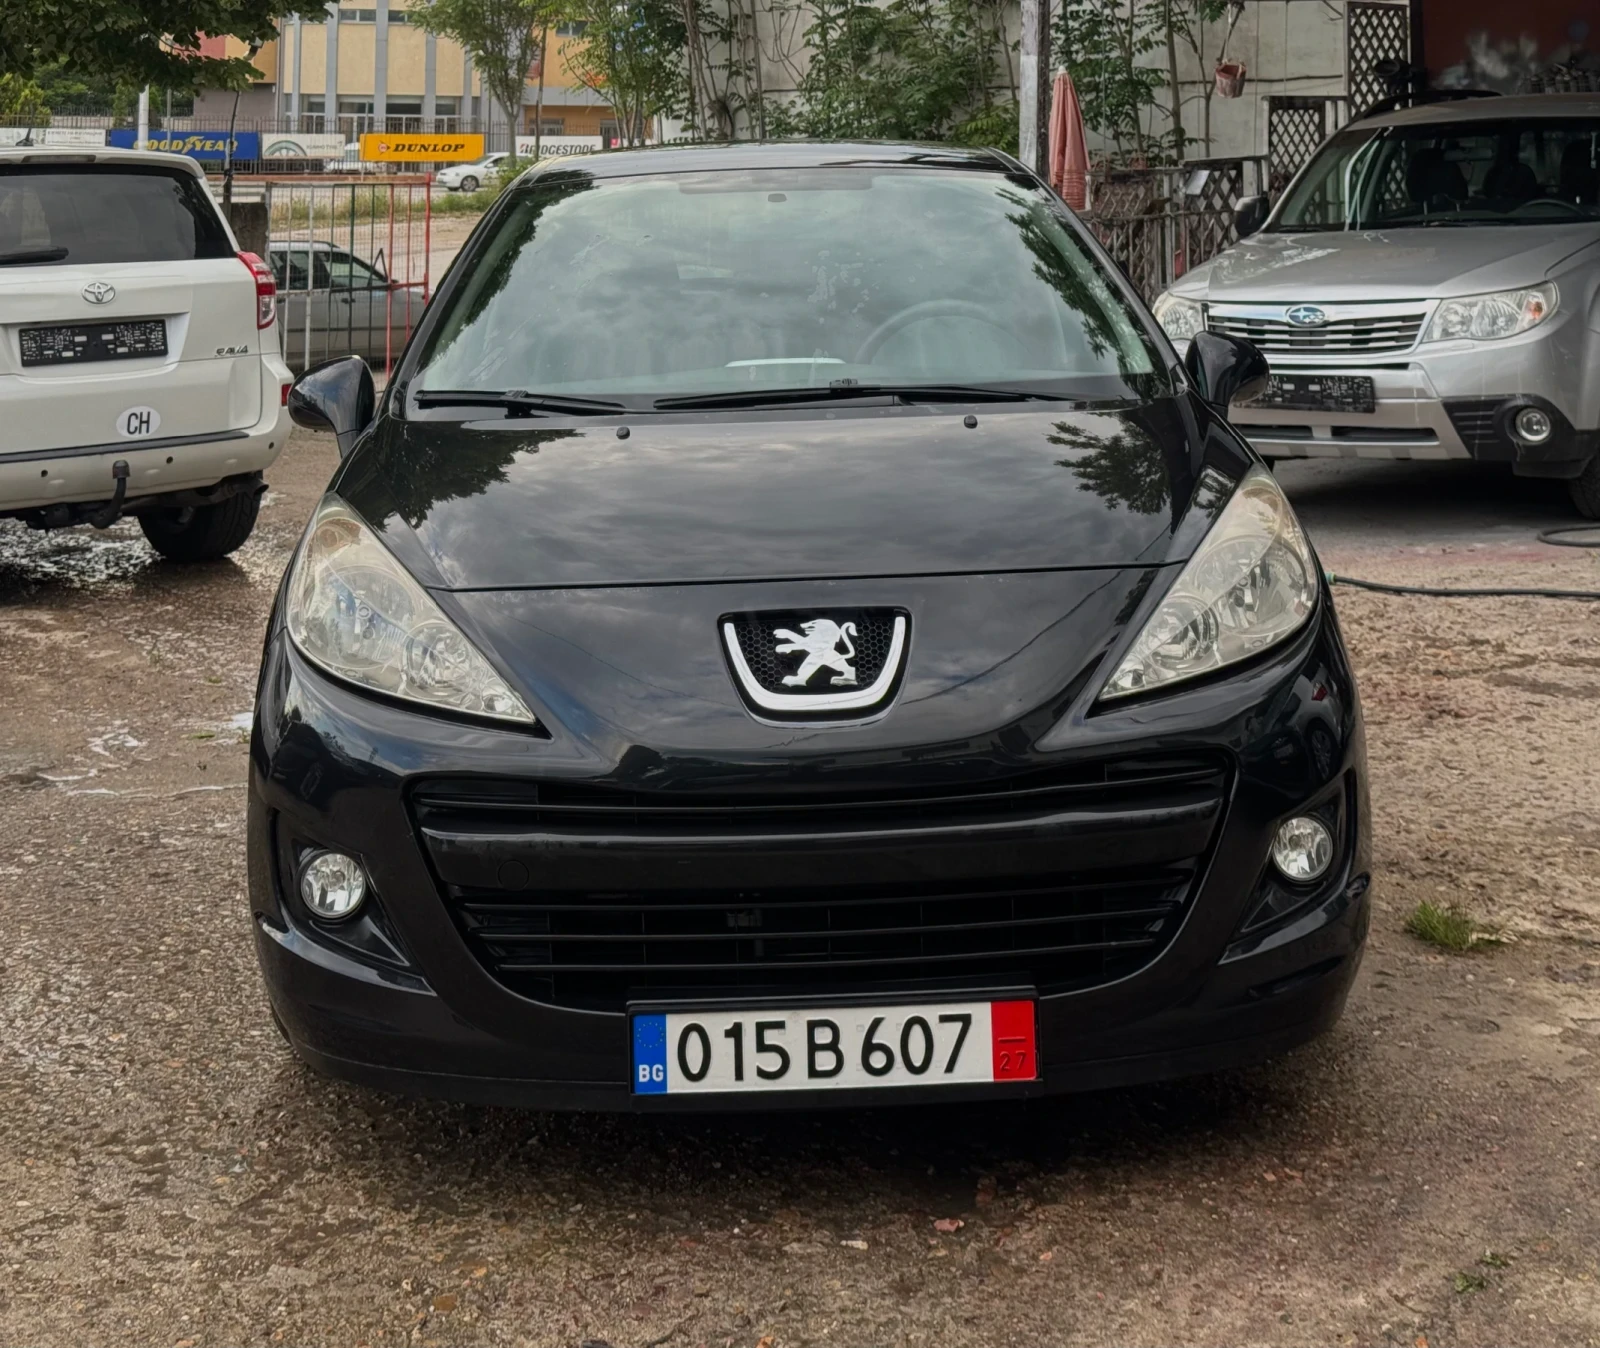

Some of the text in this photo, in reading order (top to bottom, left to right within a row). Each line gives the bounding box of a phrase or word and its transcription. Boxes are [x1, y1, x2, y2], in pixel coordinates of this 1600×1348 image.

[393, 143, 465, 152] DUNLOP
[519, 143, 597, 155] BRDGESTONE
[126, 411, 151, 435] CH
[999, 1050, 1027, 1072] 27
[638, 1064, 664, 1083] BG
